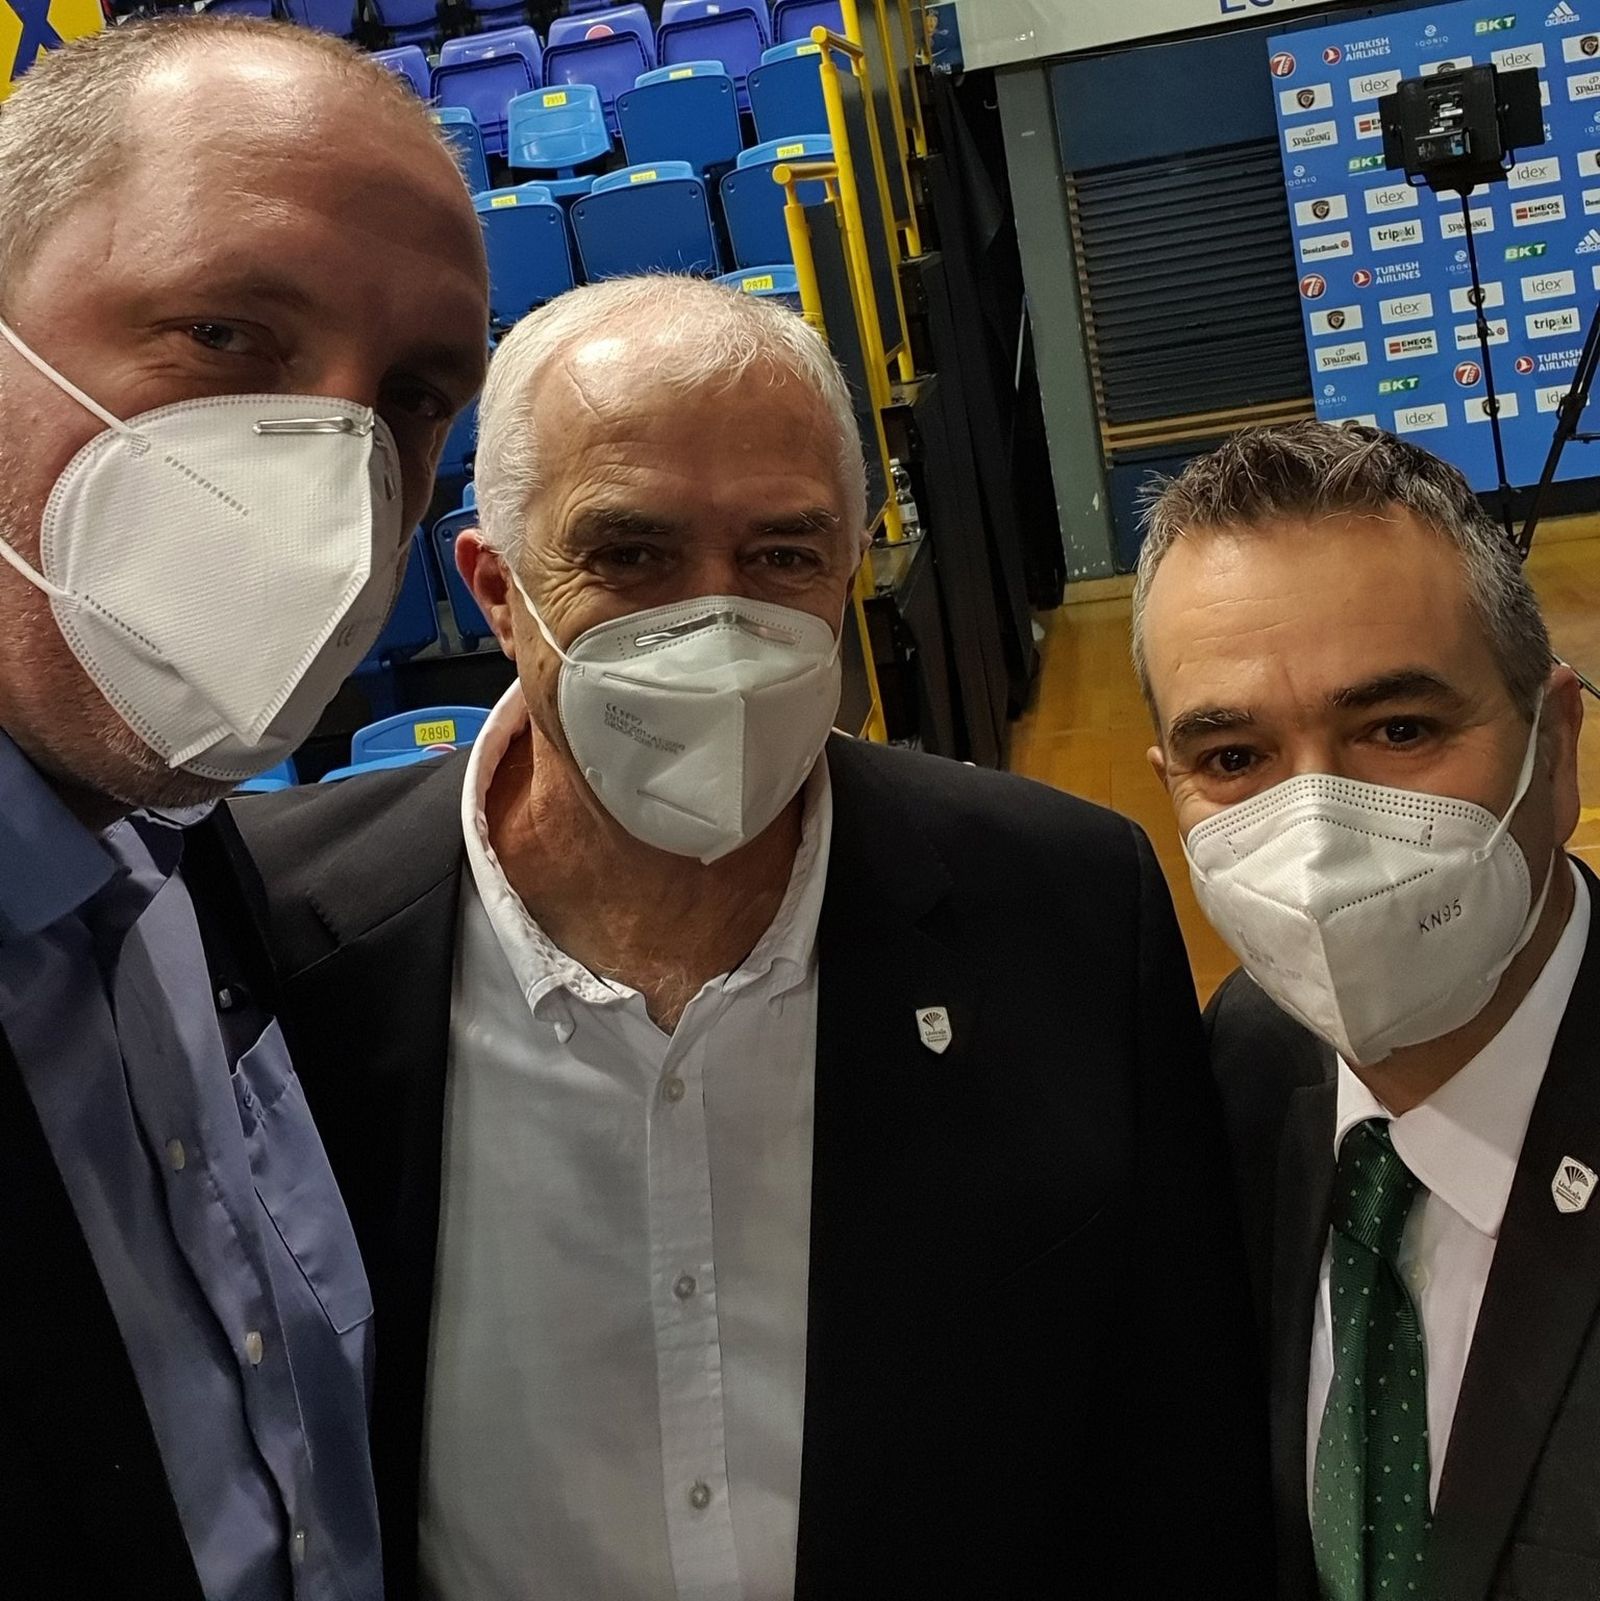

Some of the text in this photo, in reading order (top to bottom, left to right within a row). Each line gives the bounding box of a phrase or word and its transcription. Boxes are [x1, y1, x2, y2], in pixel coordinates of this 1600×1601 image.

[1475, 16, 1516, 33] BKT
[1545, 13, 1580, 27] adidas
[1344, 37, 1390, 52] TURKISH
[1345, 46, 1391, 62] AIRLINES
[1502, 50, 1532, 67] idex
[1360, 79, 1390, 93] idex
[1292, 131, 1331, 147] SPALDING
[1348, 154, 1385, 170] BKT
[1517, 166, 1547, 181] idex
[1375, 190, 1407, 205] idex
[1528, 202, 1560, 213] ENEOS
[1505, 243, 1546, 260] BKT
[1374, 261, 1420, 275] TURKISH
[1376, 270, 1421, 285] AIRLINES
[1532, 279, 1562, 293] idex
[1390, 301, 1420, 316] idex
[1402, 336, 1432, 347] ENEOS
[1322, 352, 1361, 367] SPALDING
[1537, 349, 1583, 362] TURKISH
[1539, 357, 1580, 372] AIRLINE
[1379, 377, 1419, 392] BKT
[1405, 411, 1436, 425] idex
[420, 724, 450, 741] 2896
[1418, 898, 1462, 935] KN95
